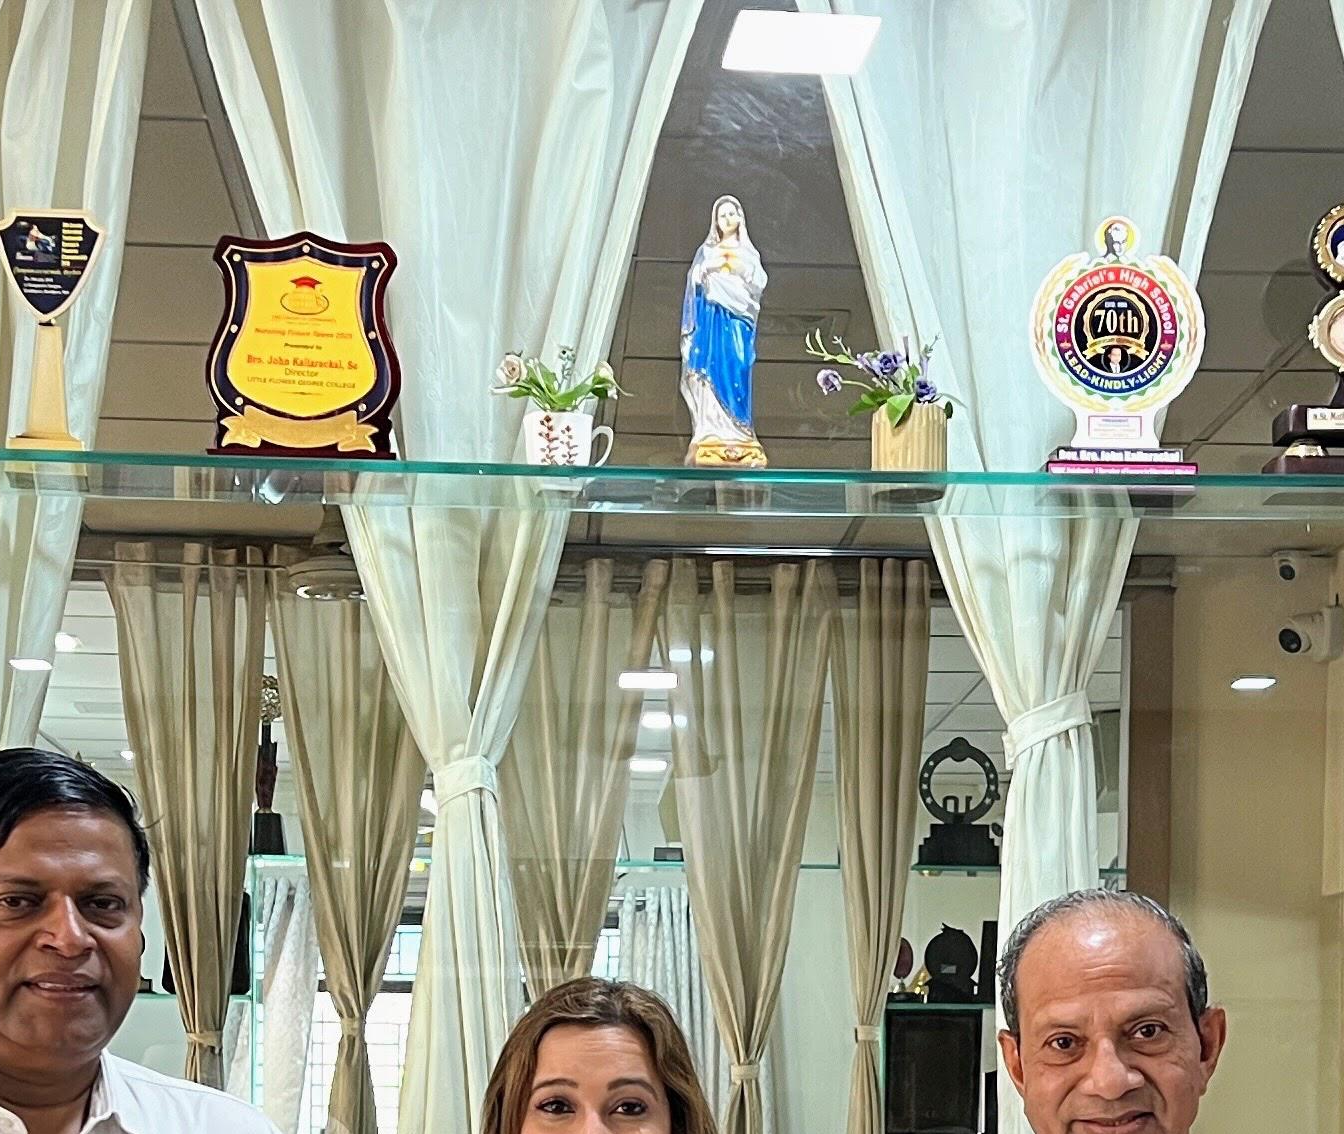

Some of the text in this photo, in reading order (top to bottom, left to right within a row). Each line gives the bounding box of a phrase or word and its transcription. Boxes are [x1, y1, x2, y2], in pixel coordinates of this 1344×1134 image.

[1119, 269, 1150, 290] High
[1150, 287, 1175, 335] School
[1094, 309, 1139, 333] 70th
[284, 367, 319, 378] Director
